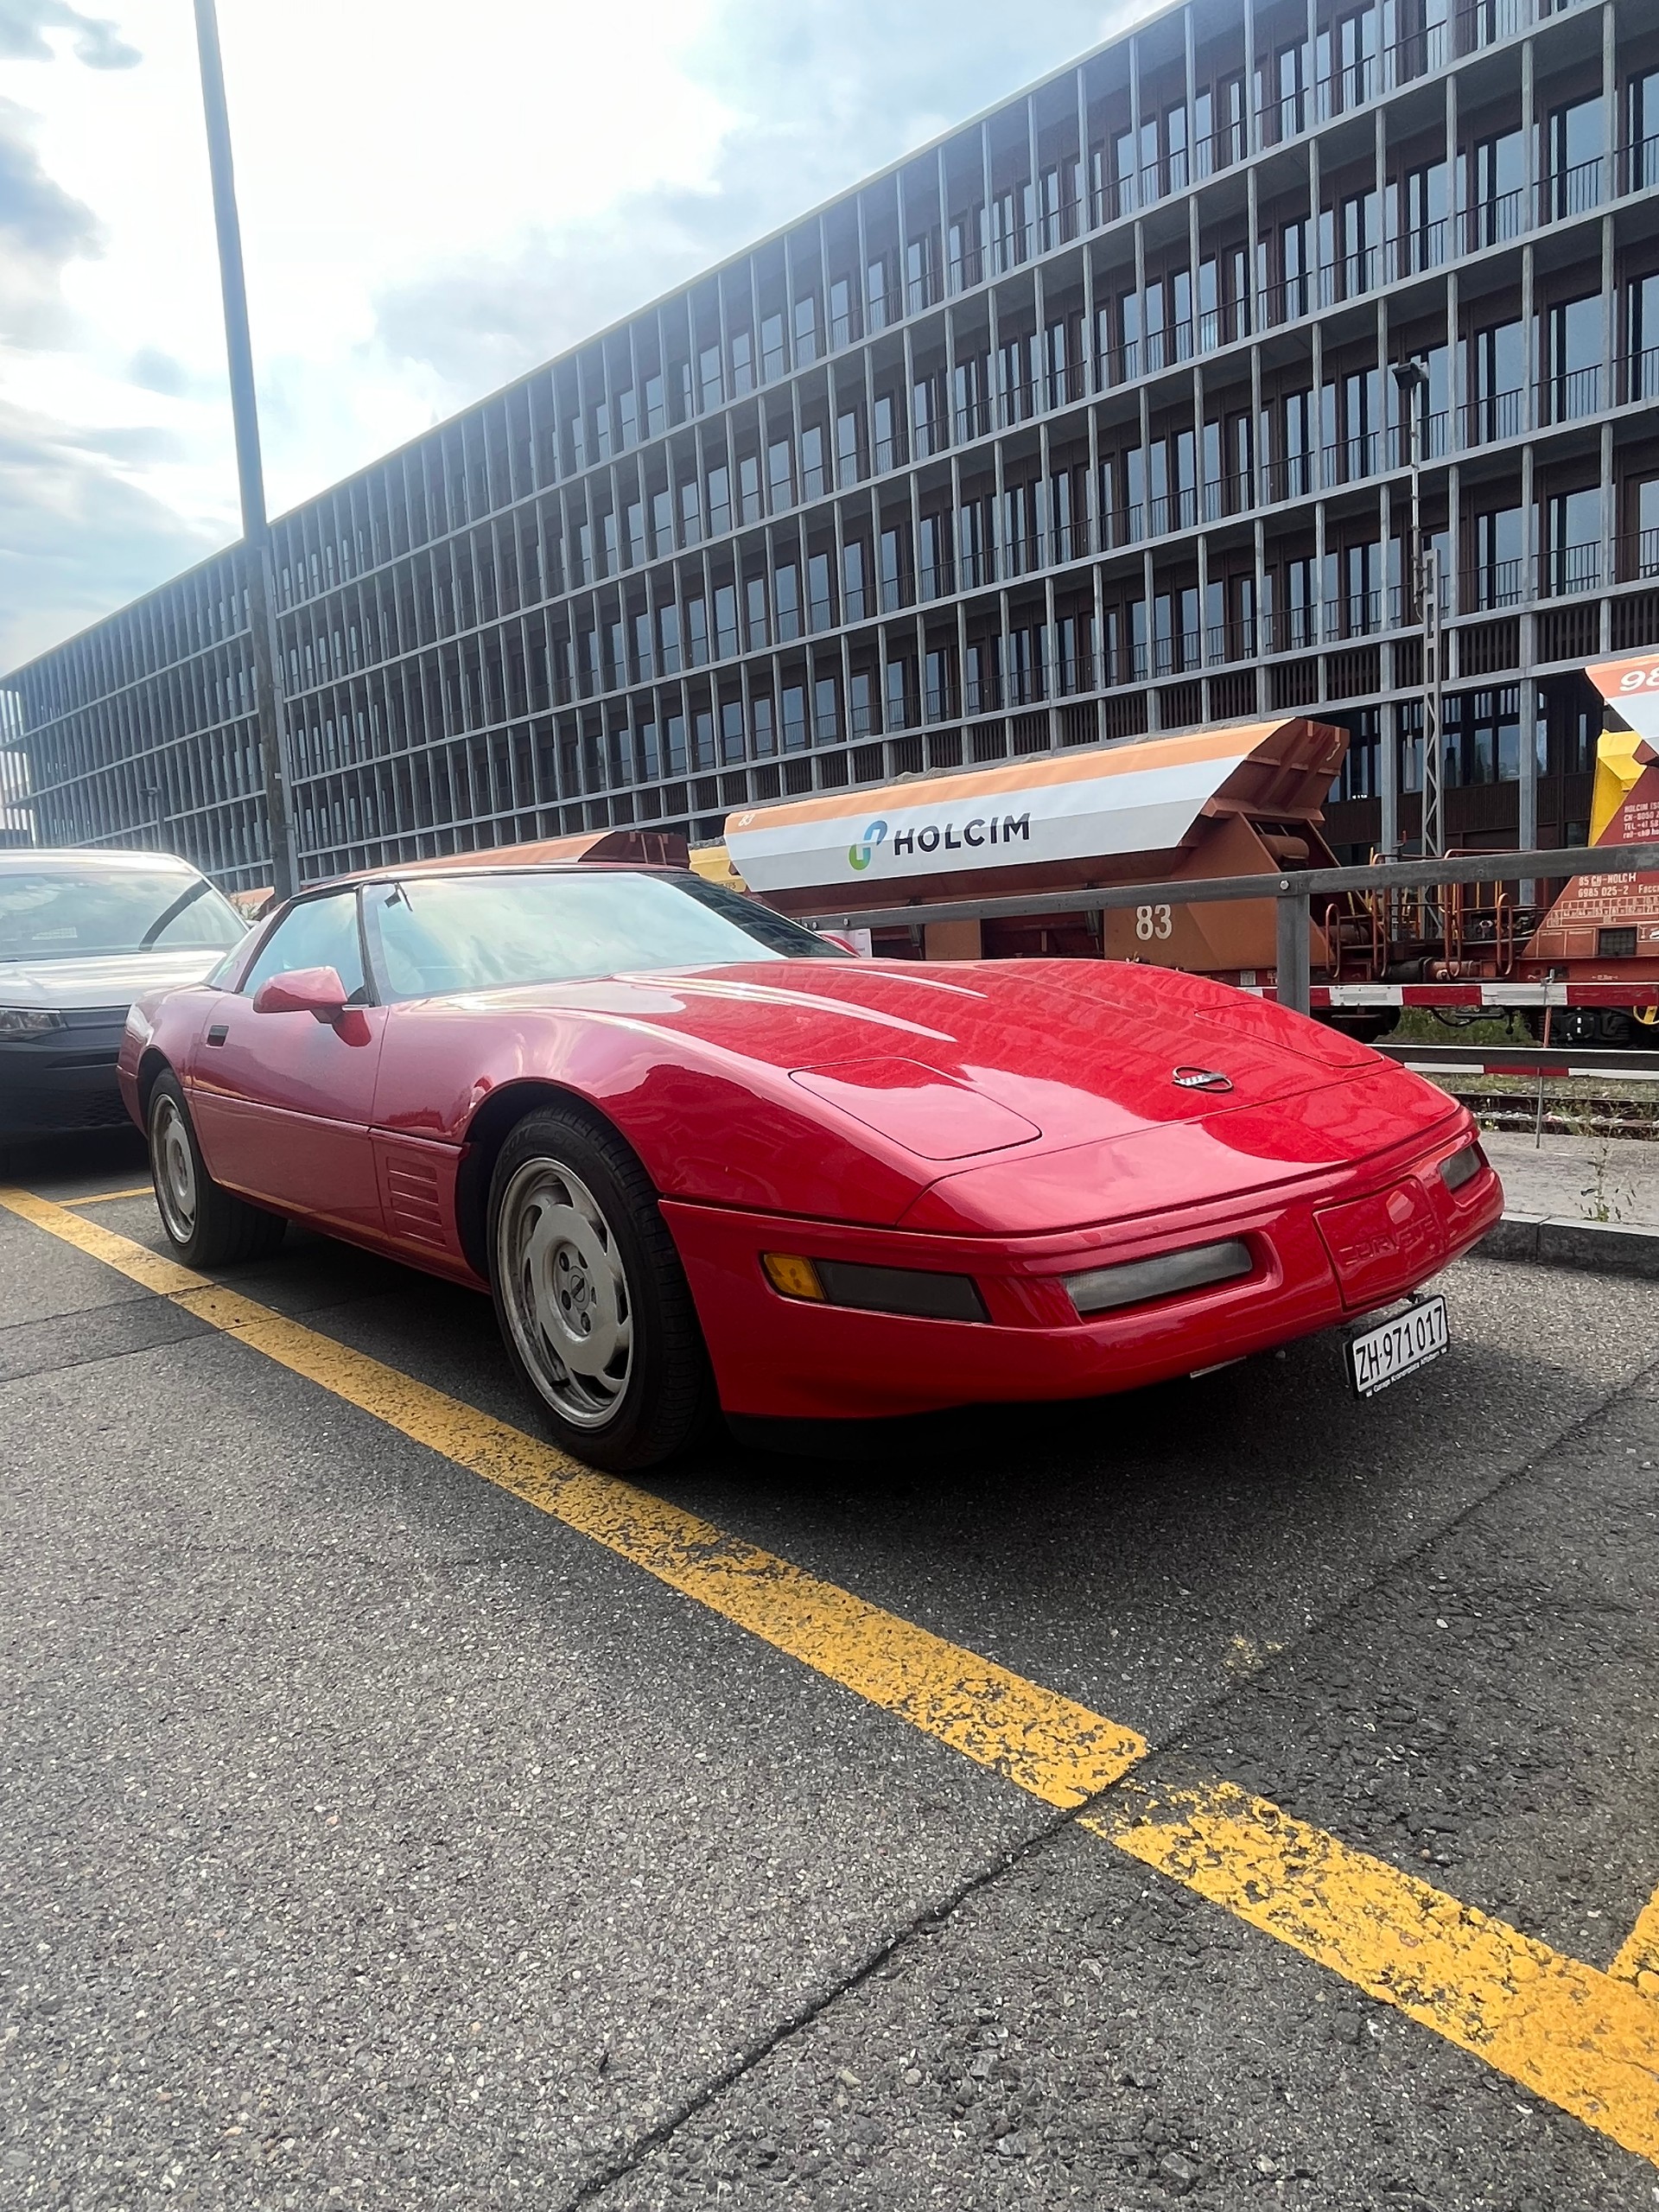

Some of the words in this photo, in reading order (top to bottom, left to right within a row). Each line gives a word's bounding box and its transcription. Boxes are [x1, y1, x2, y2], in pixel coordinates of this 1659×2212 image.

[893, 812, 1031, 855] HOLCIM
[1578, 887, 1599, 898] 6985
[1601, 885, 1629, 897] 025-2
[1135, 904, 1173, 941] 83
